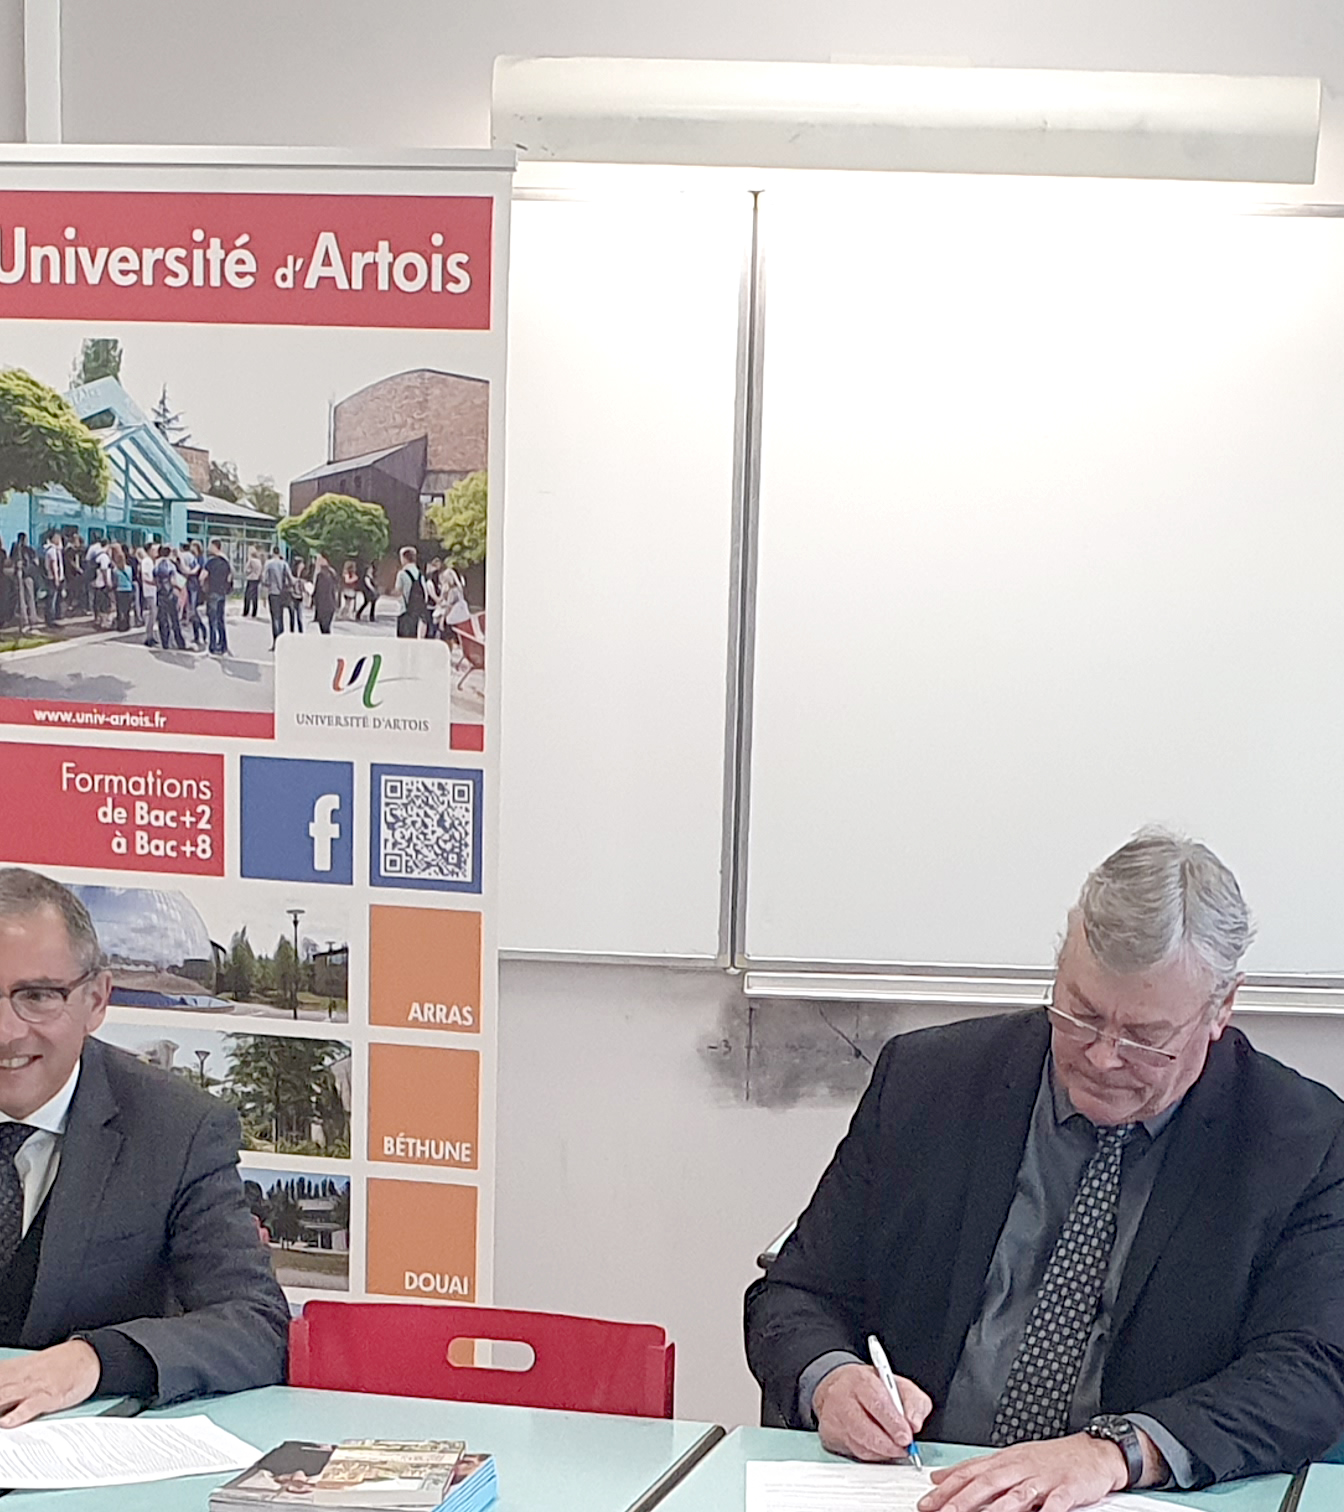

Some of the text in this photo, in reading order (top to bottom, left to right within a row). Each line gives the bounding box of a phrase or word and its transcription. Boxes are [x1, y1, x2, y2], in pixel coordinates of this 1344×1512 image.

[274, 230, 472, 295] d'Artois
[34, 707, 167, 730] www.univ-artois.fr
[296, 712, 430, 732] UNIVERSITÉ D'ARTOIS
[61, 761, 212, 800] Formations
[97, 797, 128, 824] de
[112, 830, 127, 855] à
[408, 1002, 474, 1026] ARRAS
[383, 1132, 472, 1163] BÉTHUNE
[404, 1271, 469, 1295] DOUAI
